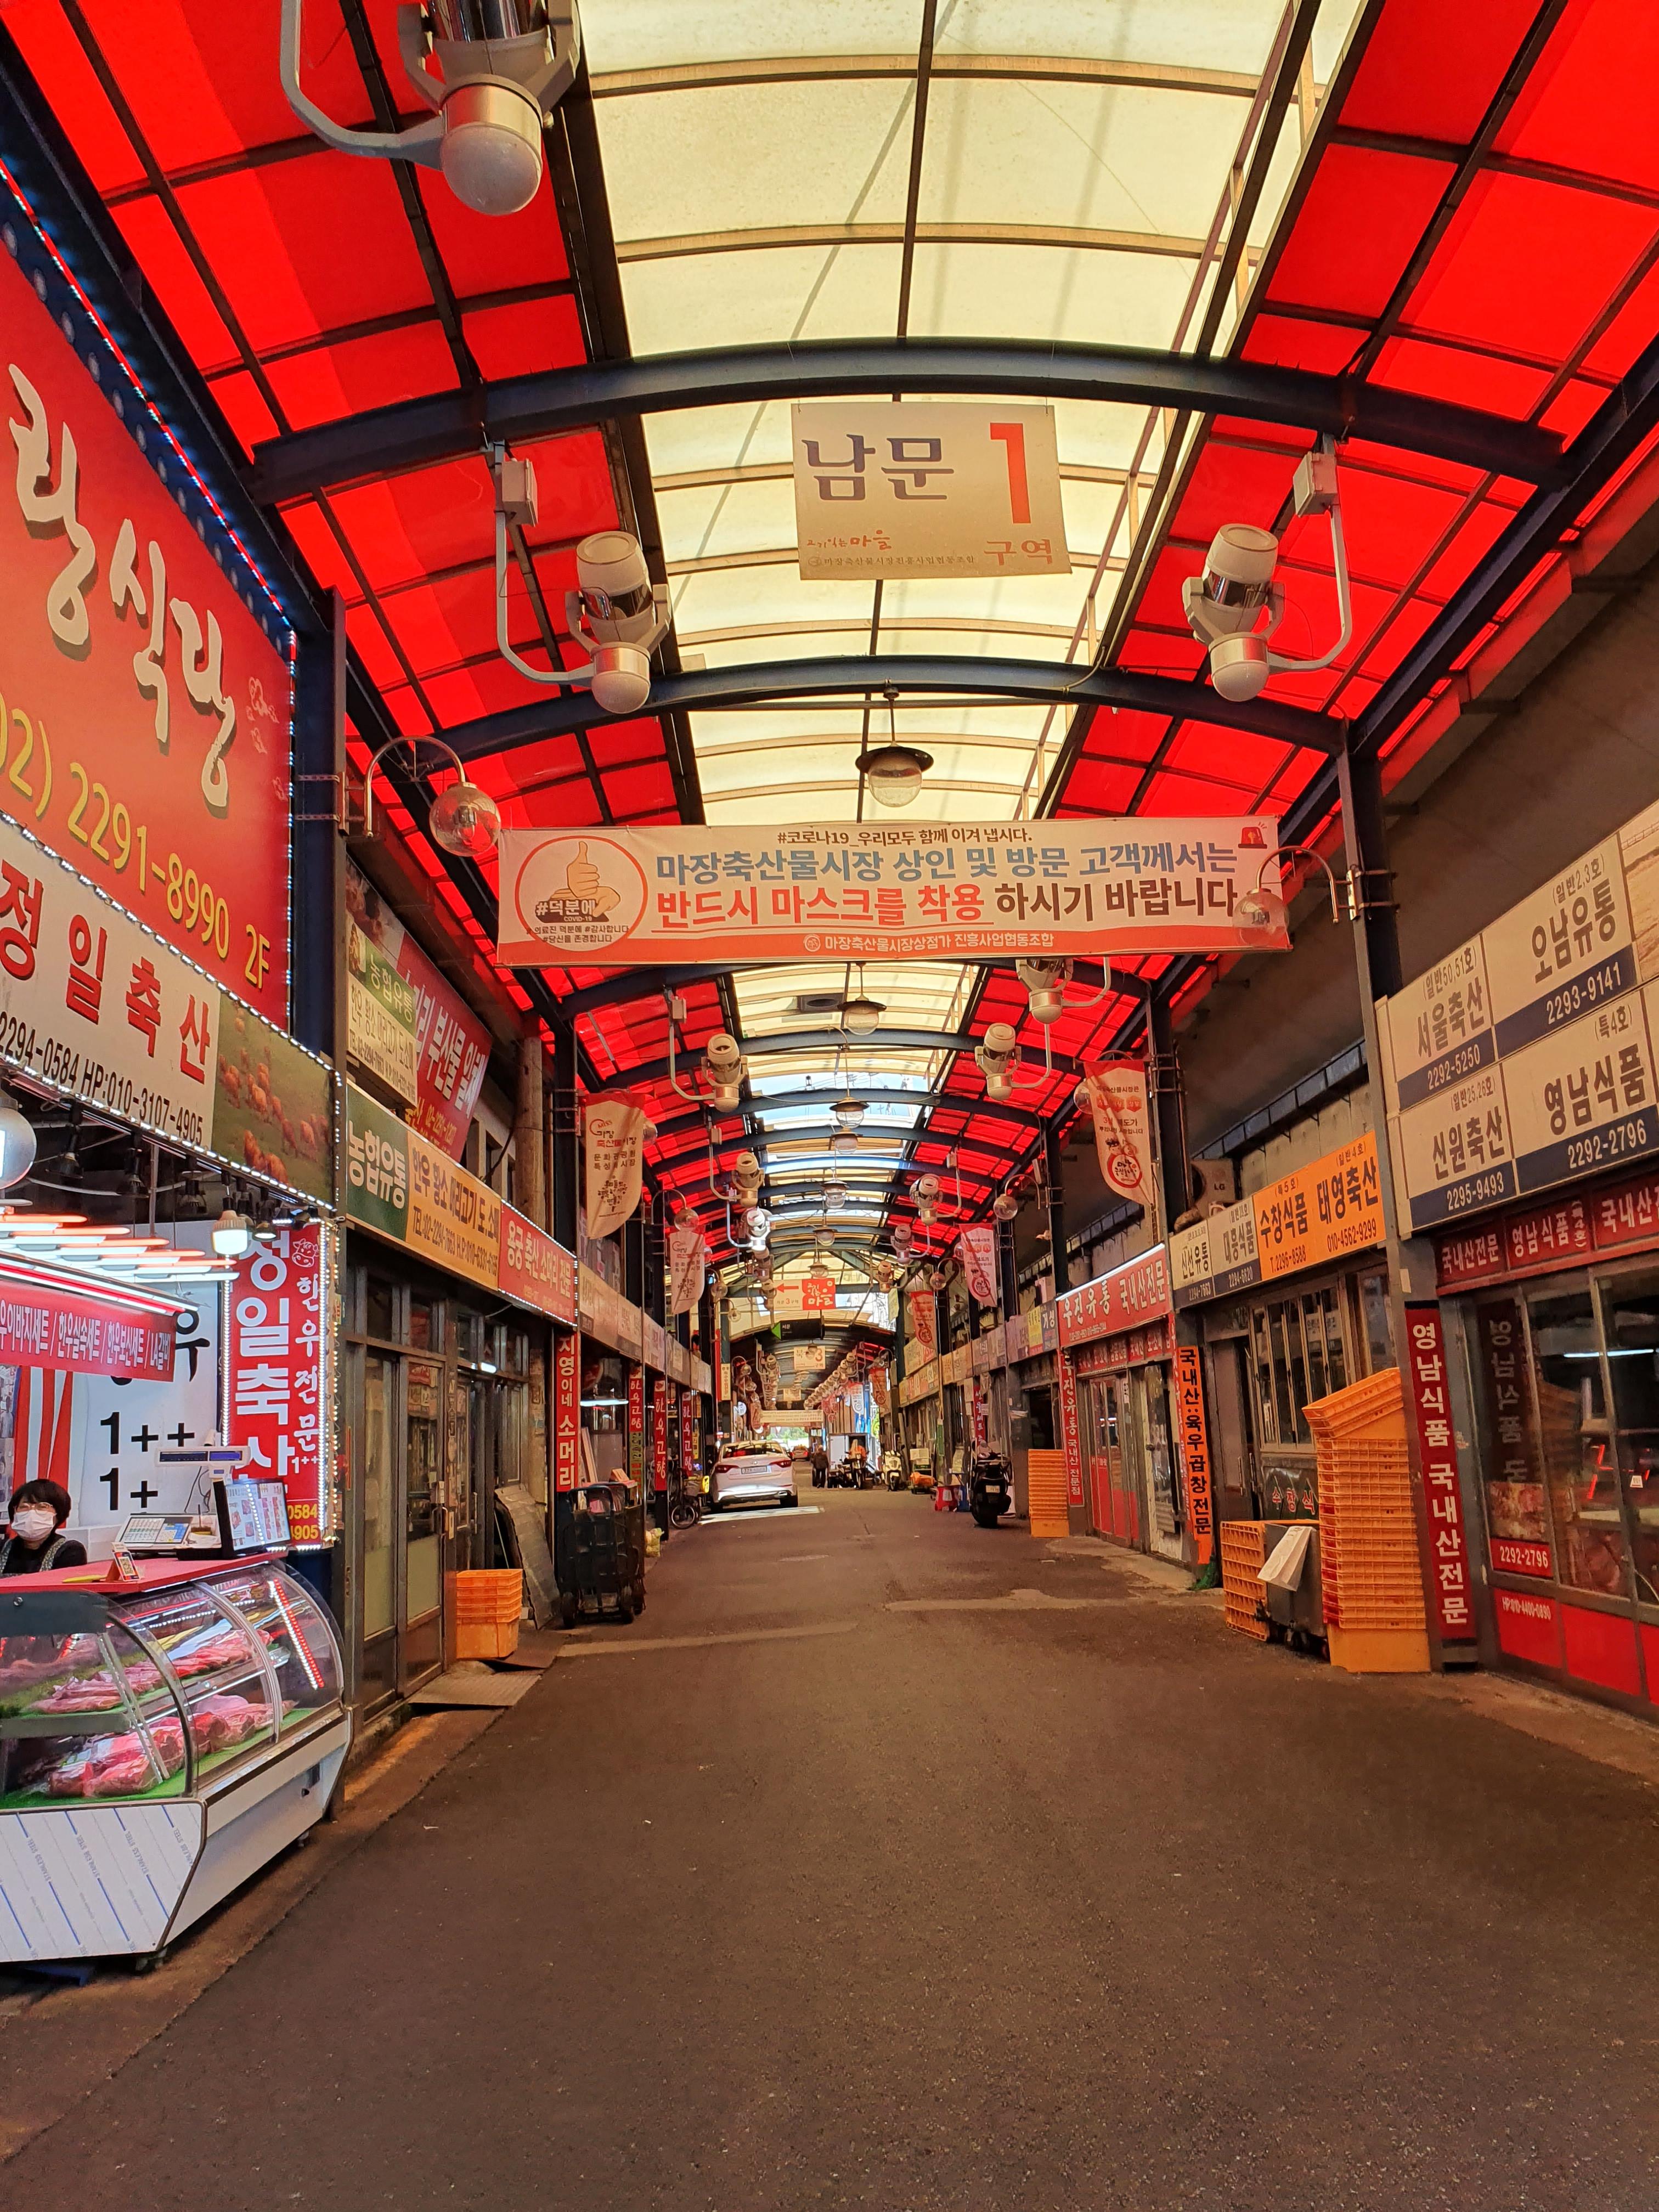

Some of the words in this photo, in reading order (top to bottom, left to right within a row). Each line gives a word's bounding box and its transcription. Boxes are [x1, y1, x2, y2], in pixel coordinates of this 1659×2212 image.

[802, 434, 954, 501] 남문
[990, 422, 1031, 524] 1
[850, 530, 891, 550] 마을
[984, 538, 1052, 566] 구역
[919, 827, 949, 844] 함께
[952, 826, 981, 843] 이겨
[67, 762, 229, 960] 2291-8990
[245, 924, 270, 989] 2F
[658, 849, 883, 885] 마장축산물시장
[893, 849, 955, 882] 상인
[967, 848, 996, 879] 및
[1007, 846, 1070, 878] 방문
[1079, 842, 1237, 877] 고객께서는
[535, 898, 597, 918] #덕분에
[560, 925, 583, 934] 덕분에
[585, 924, 630, 934] #감사합니다
[658, 885, 759, 928] 반드시
[774, 885, 906, 926] 마스크를
[918, 883, 984, 923] 착용
[995, 881, 1092, 922] 하시기
[1105, 877, 1238, 918] 바랍니다
[574, 933, 613, 943] 존경합니다
[955, 932, 1054, 949] 진흥사업협동조합
[1531, 878, 1616, 984] 오남유통
[351, 981, 362, 1029] 한우
[370, 951, 412, 1025] 농협유통
[1545, 961, 1622, 1026] 2293-9141
[1417, 976, 1485, 1059] 서울축산
[435, 1002, 466, 1099] 부산물
[1427, 1042, 1481, 1092] 2292-5250
[82, 1061, 204, 1146] HP:010-3107-4905
[1544, 1042, 1646, 1137] 영남식품
[348, 1114, 406, 1213] 농협유통
[1431, 1105, 1505, 1181] 신원축산
[1568, 1118, 1646, 1170] 2292-2796
[413, 1145, 430, 1200] 한우
[1317, 1155, 1379, 1224] 대영축산
[1446, 1170, 1504, 1212] 2295-9493
[1223, 1221, 1255, 1265] 대흥식품
[1259, 1193, 1310, 1248] 수창식품
[1326, 1218, 1377, 1253] 010-4562-9299
[1442, 1232, 1499, 1276] 국내산전문
[1512, 1210, 1569, 1259] 영남식품
[1601, 1184, 1659, 1235] 국내산
[507, 1217, 523, 1272] 용궁
[524, 1228, 539, 1280] 축산
[540, 1242, 557, 1291] 소머리
[560, 1256, 571, 1299] 전문
[1063, 1279, 1111, 1330] 우진유통
[294, 1277, 319, 1452] 한우전문
[558, 1336, 575, 1407] 지영이네
[815, 1348, 822, 1362] 3
[1413, 1322, 1451, 1448] 영남식품
[100, 1412, 194, 1454] 1++
[557, 1414, 576, 1489] 소머리
[655, 1397, 666, 1480] 한우고향
[682, 1404, 692, 1470] 한우고향
[1067, 1438, 1081, 1467] 국내산
[100, 1468, 158, 1510] 1+
[1069, 1468, 1081, 1496] 전문점
[1429, 1464, 1469, 1626] 국내산전문
[1499, 1543, 1550, 1570] 2292-2796
